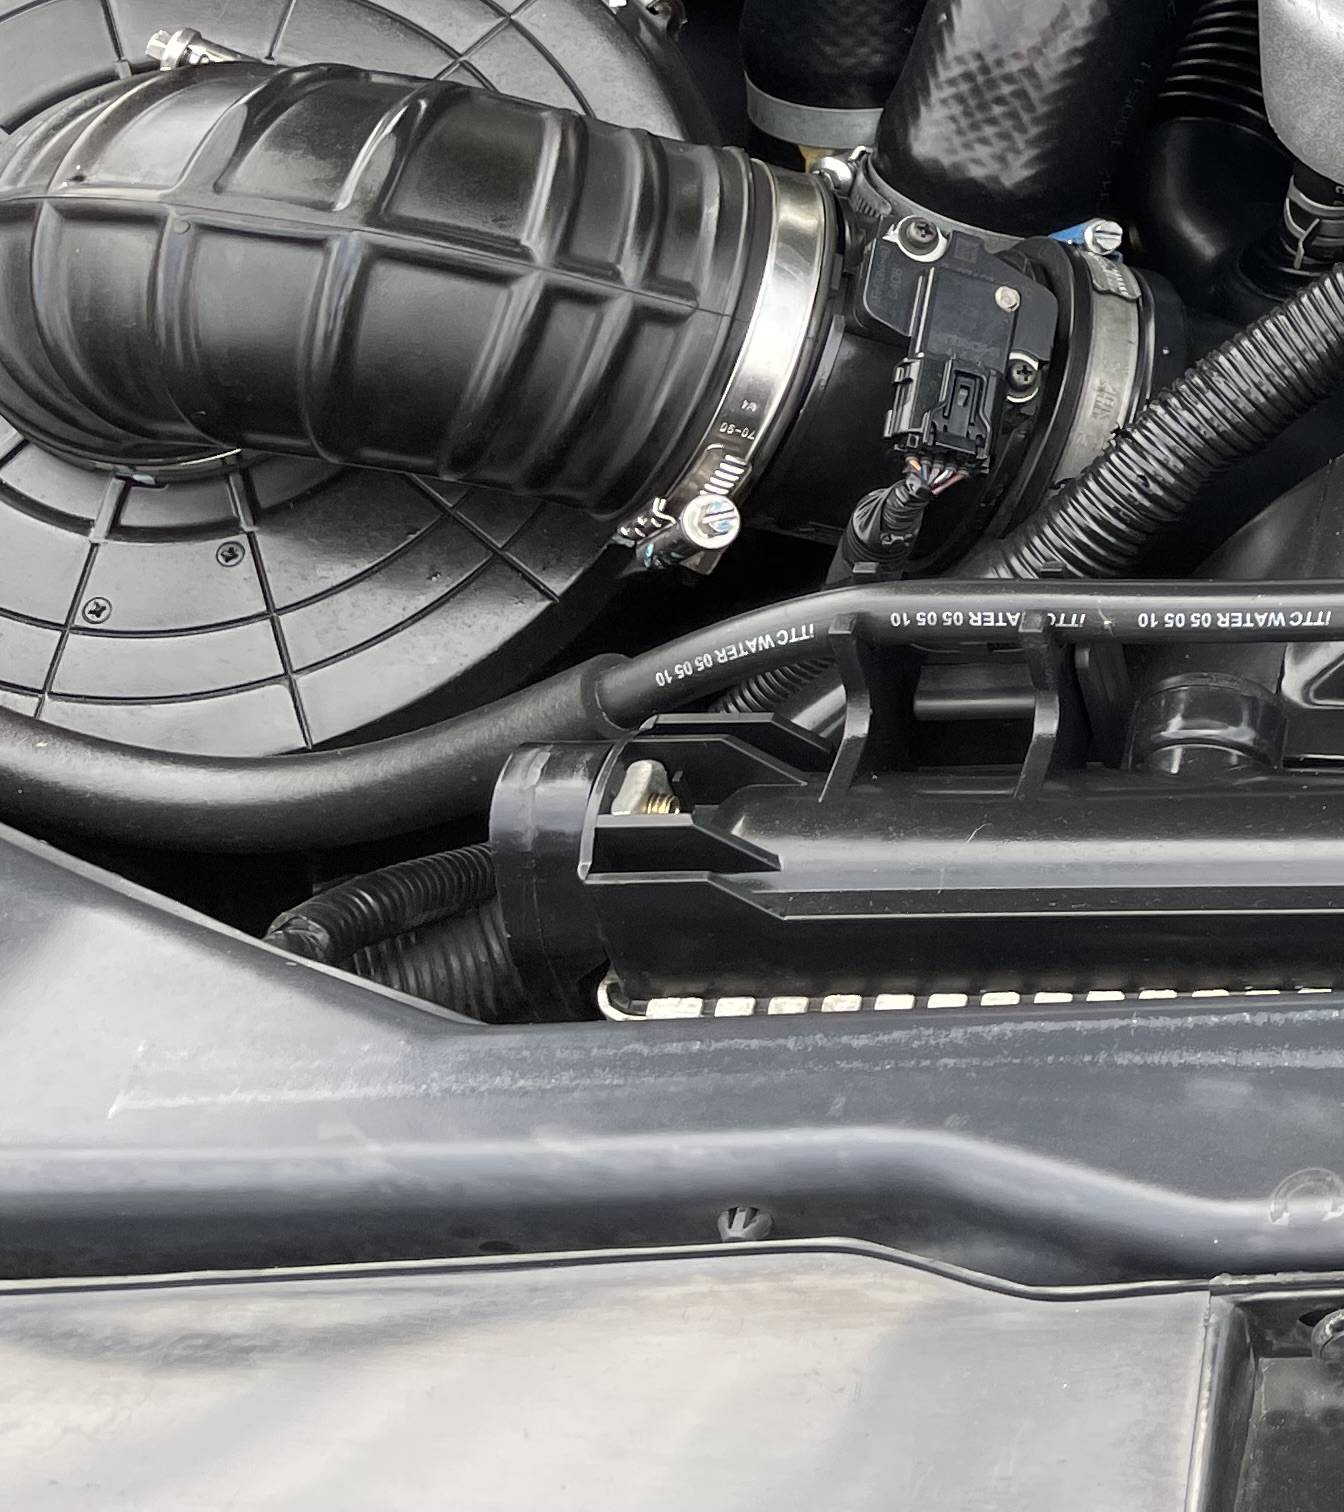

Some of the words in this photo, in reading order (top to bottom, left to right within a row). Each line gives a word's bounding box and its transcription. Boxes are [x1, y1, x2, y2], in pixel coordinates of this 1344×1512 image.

[890, 611, 912, 627] 10
[915, 611, 938, 627] 05
[941, 611, 964, 627] 05
[968, 611, 1022, 627] ATER
[1137, 612, 1159, 628] 10
[1163, 612, 1186, 628] 05
[1189, 612, 1212, 628] 05
[1216, 611, 1286, 628] WATER
[715, 632, 777, 666] WATER
[676, 661, 694, 681] 05
[696, 654, 714, 673] 05
[654, 671, 674, 687] 10
